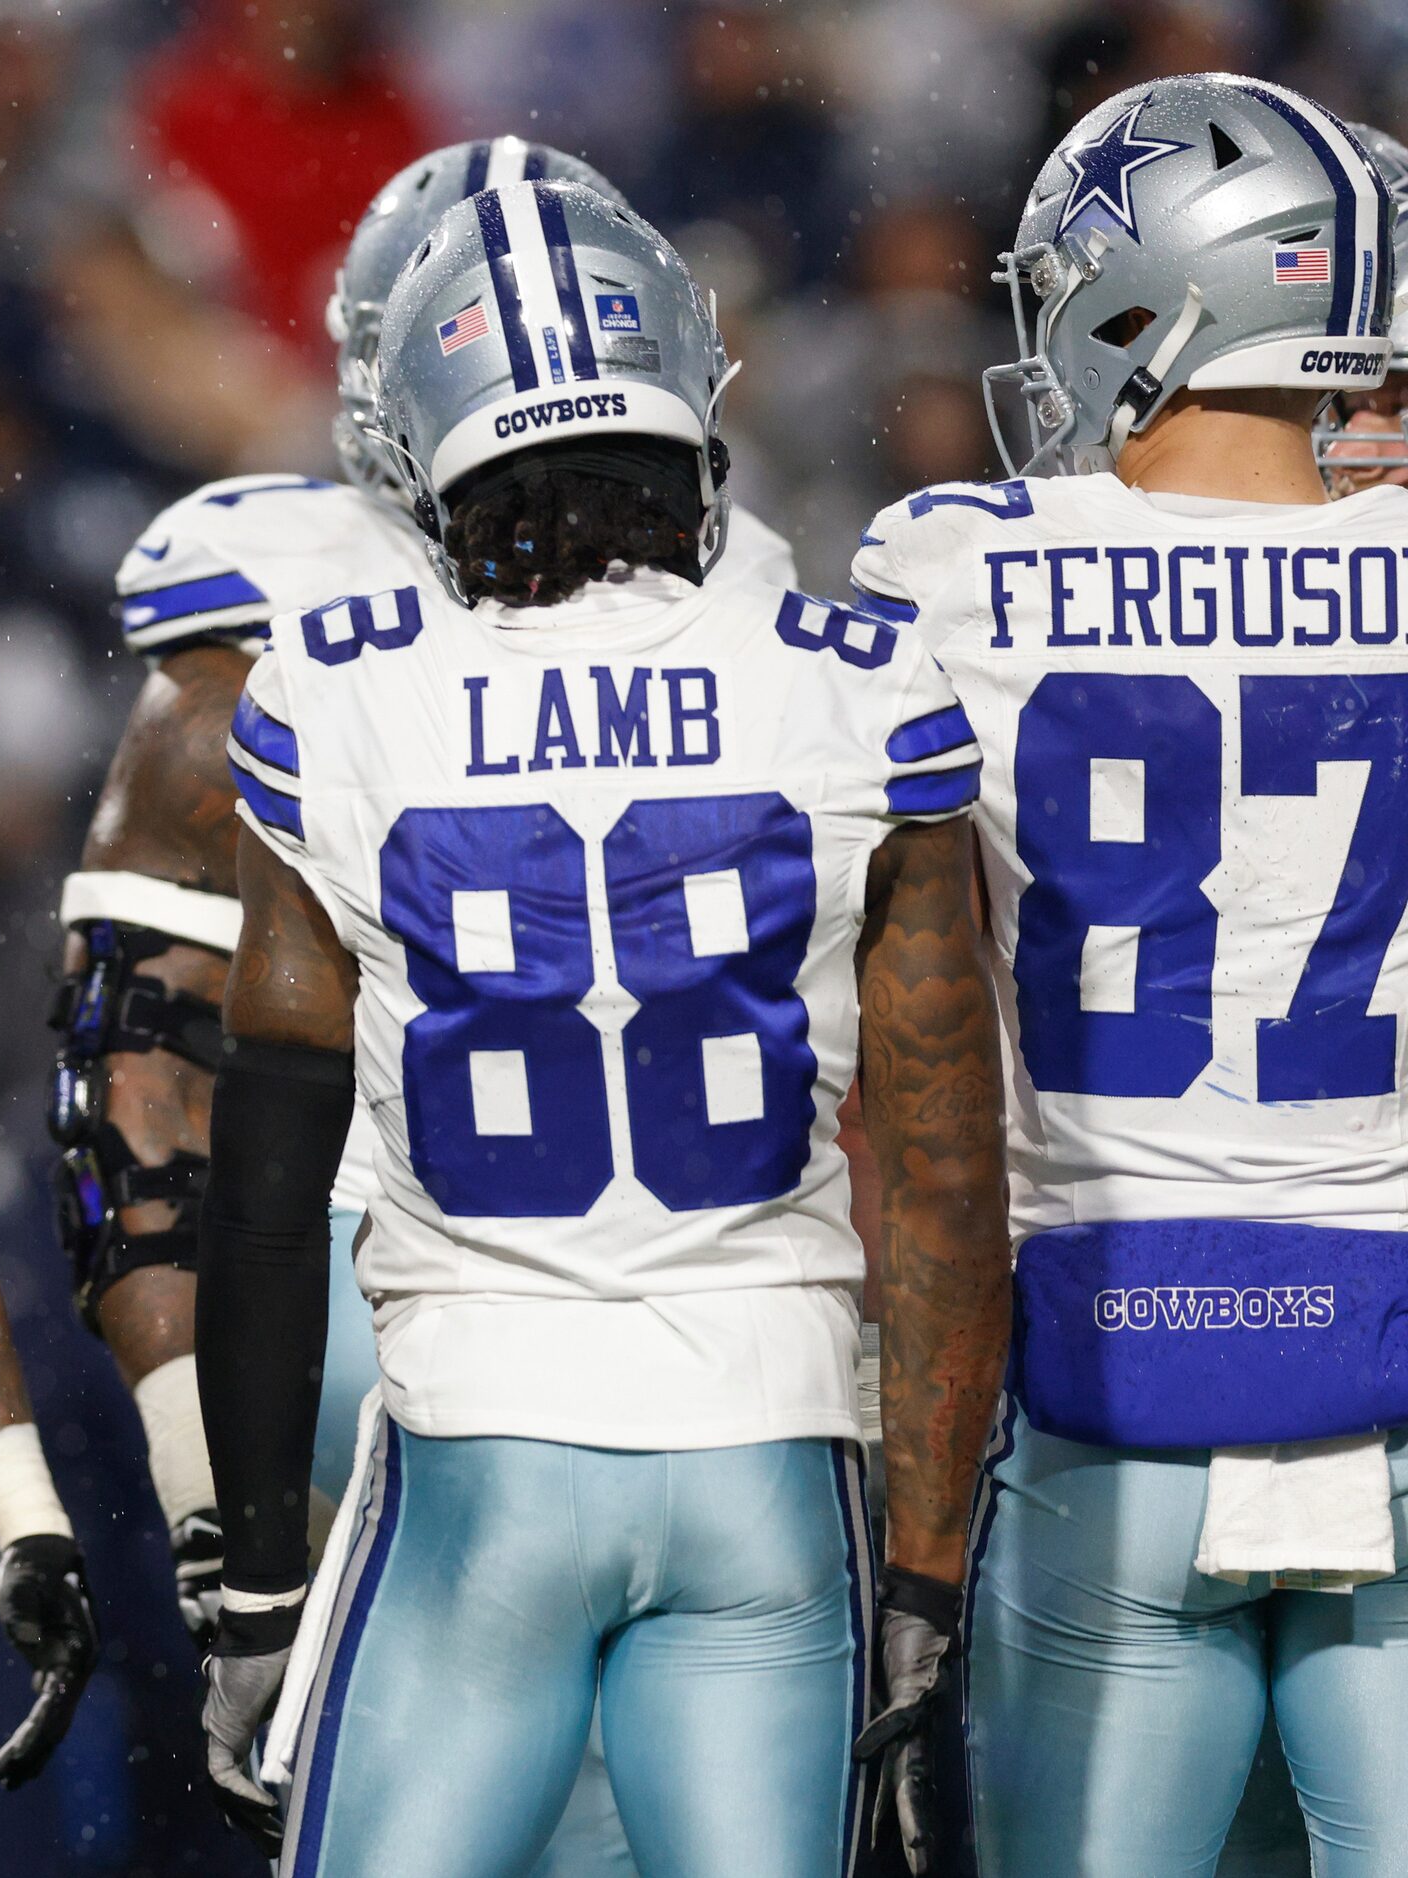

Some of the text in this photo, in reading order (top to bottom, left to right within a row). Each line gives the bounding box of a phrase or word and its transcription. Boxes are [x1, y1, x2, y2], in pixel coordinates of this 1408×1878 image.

[494, 392, 627, 439] COWBOYS
[984, 546, 1408, 648] FERGUSO
[463, 664, 722, 777] LAMB
[1013, 670, 1408, 1104] 87
[379, 791, 818, 1218] 88
[1094, 1286, 1334, 1331] COWBOYS
